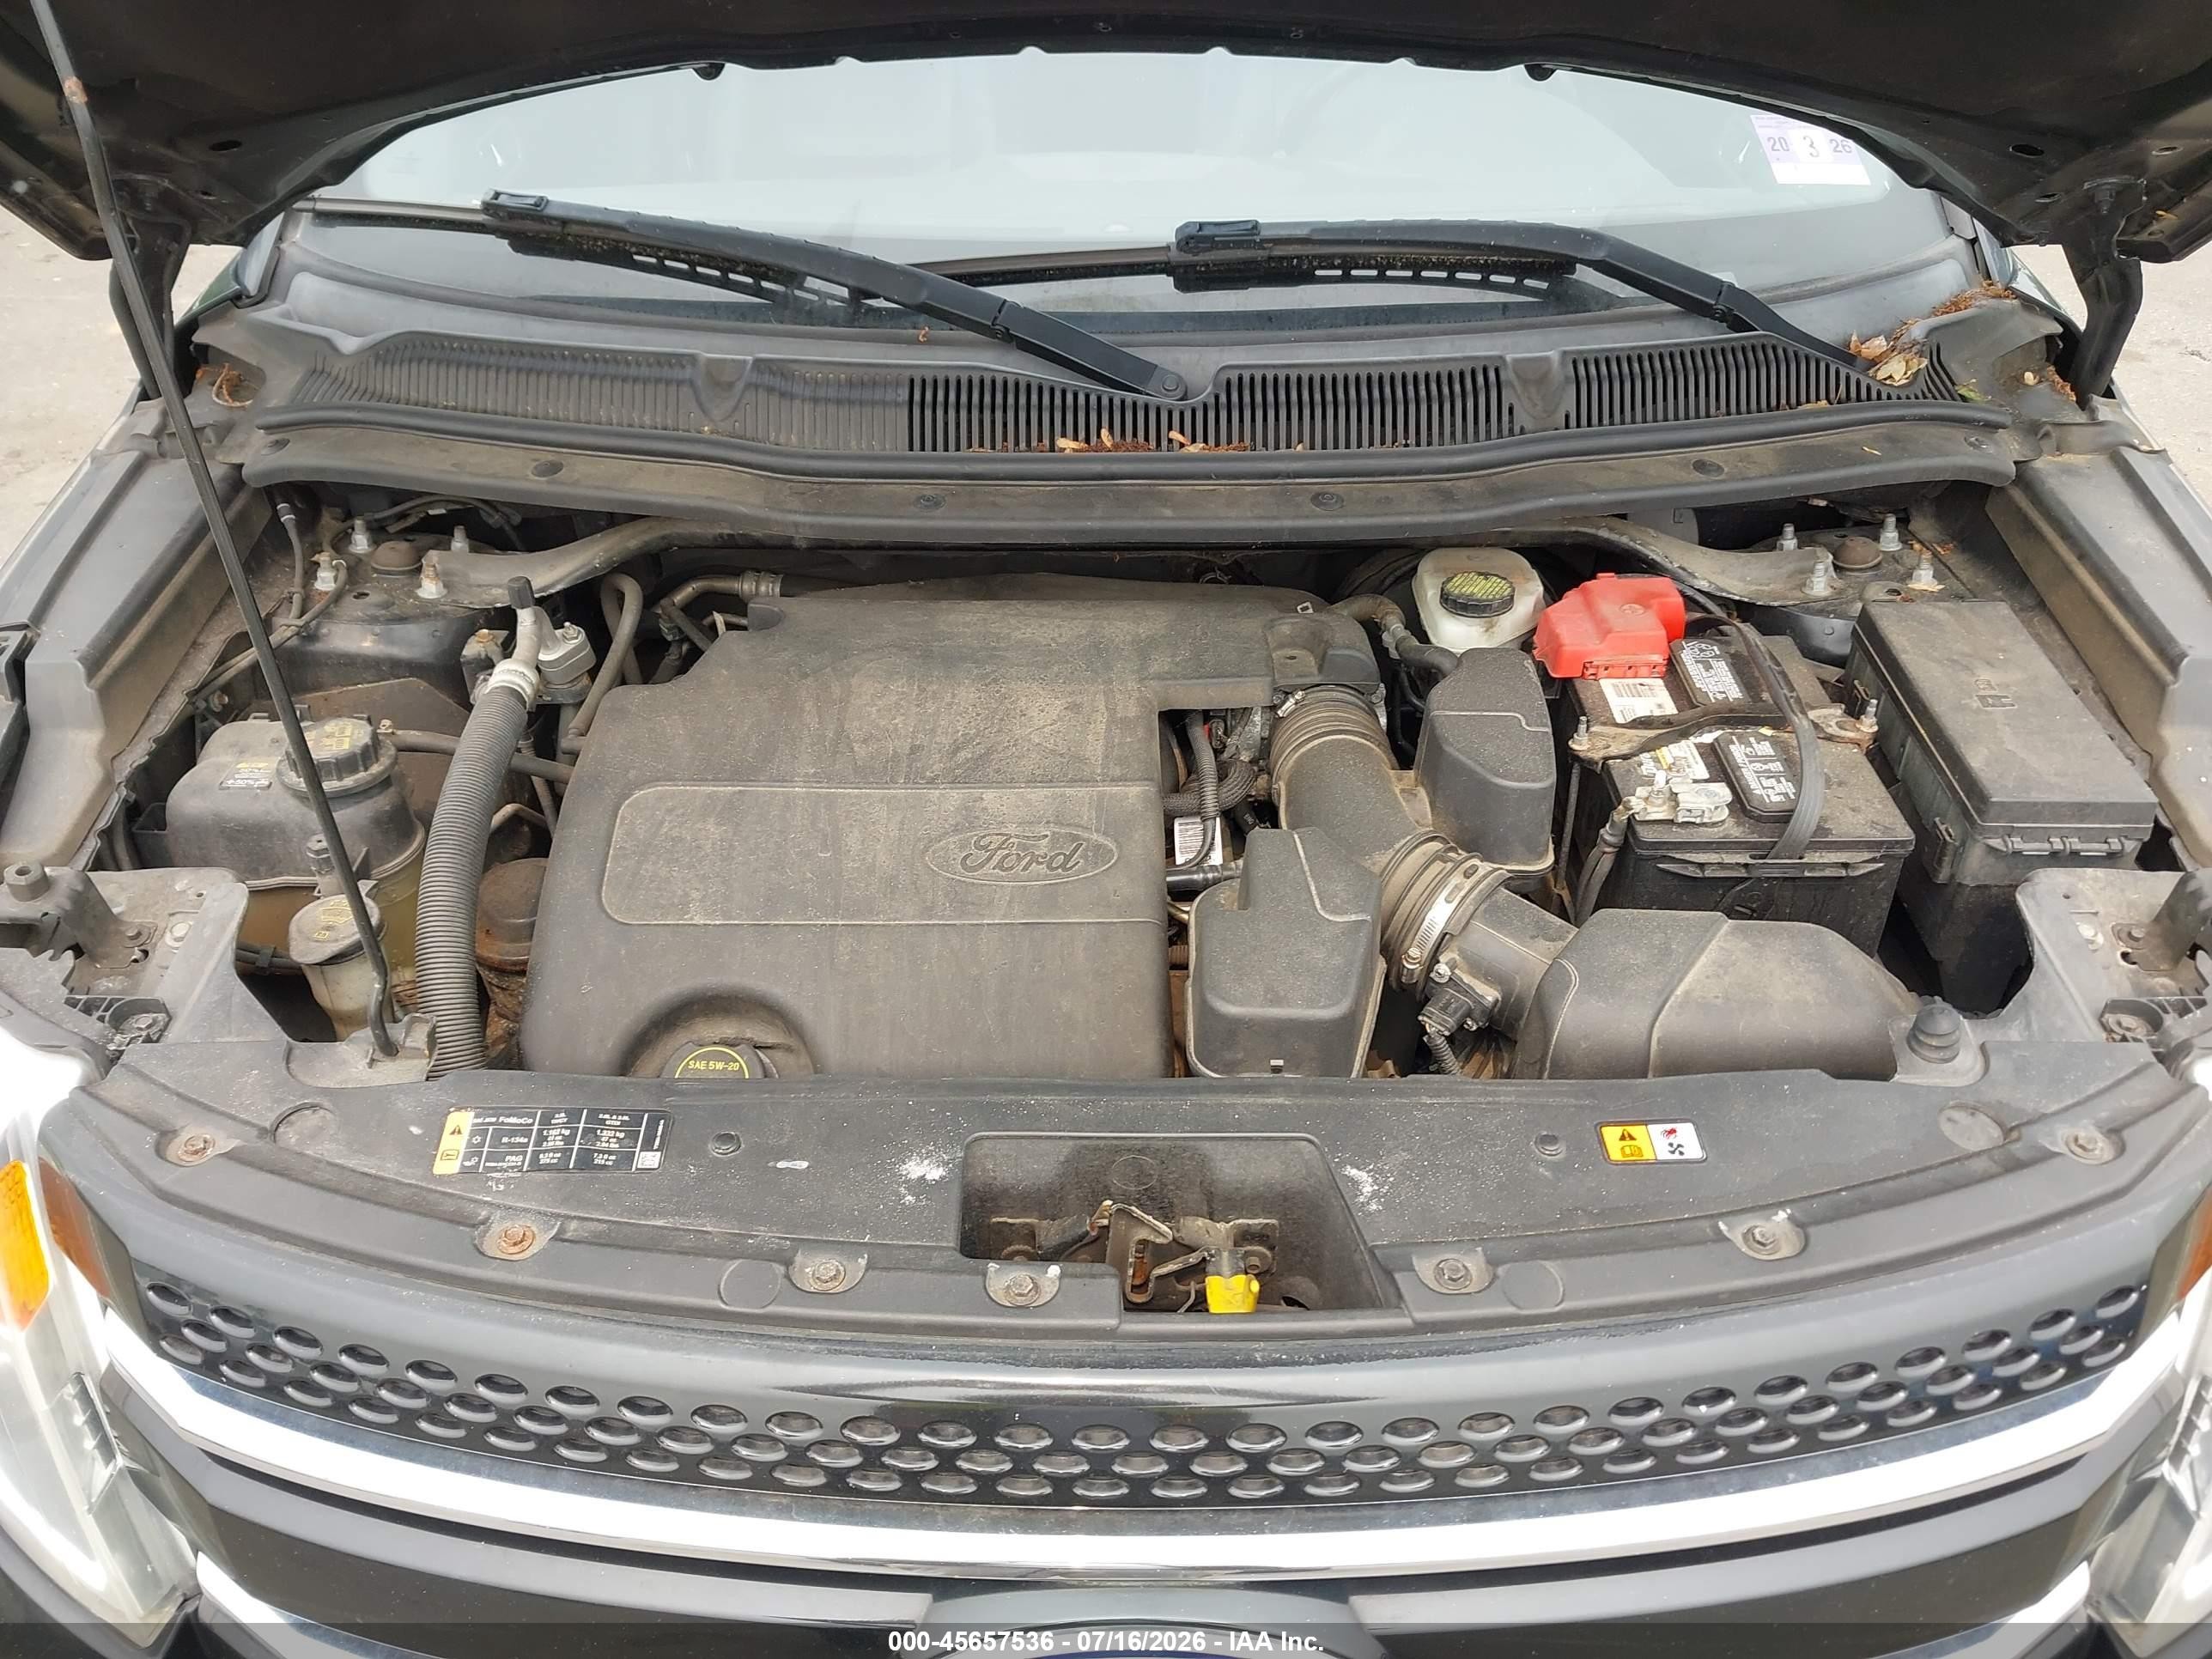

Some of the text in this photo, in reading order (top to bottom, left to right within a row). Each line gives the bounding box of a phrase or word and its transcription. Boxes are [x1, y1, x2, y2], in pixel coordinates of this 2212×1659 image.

[1766, 135, 1853, 158] 20 3 26
[959, 831, 1086, 874] Ford
[687, 1060, 740, 1071] SAE 5W-20
[498, 1115, 534, 1124] FoMoCo
[501, 1135, 529, 1144] R-134a
